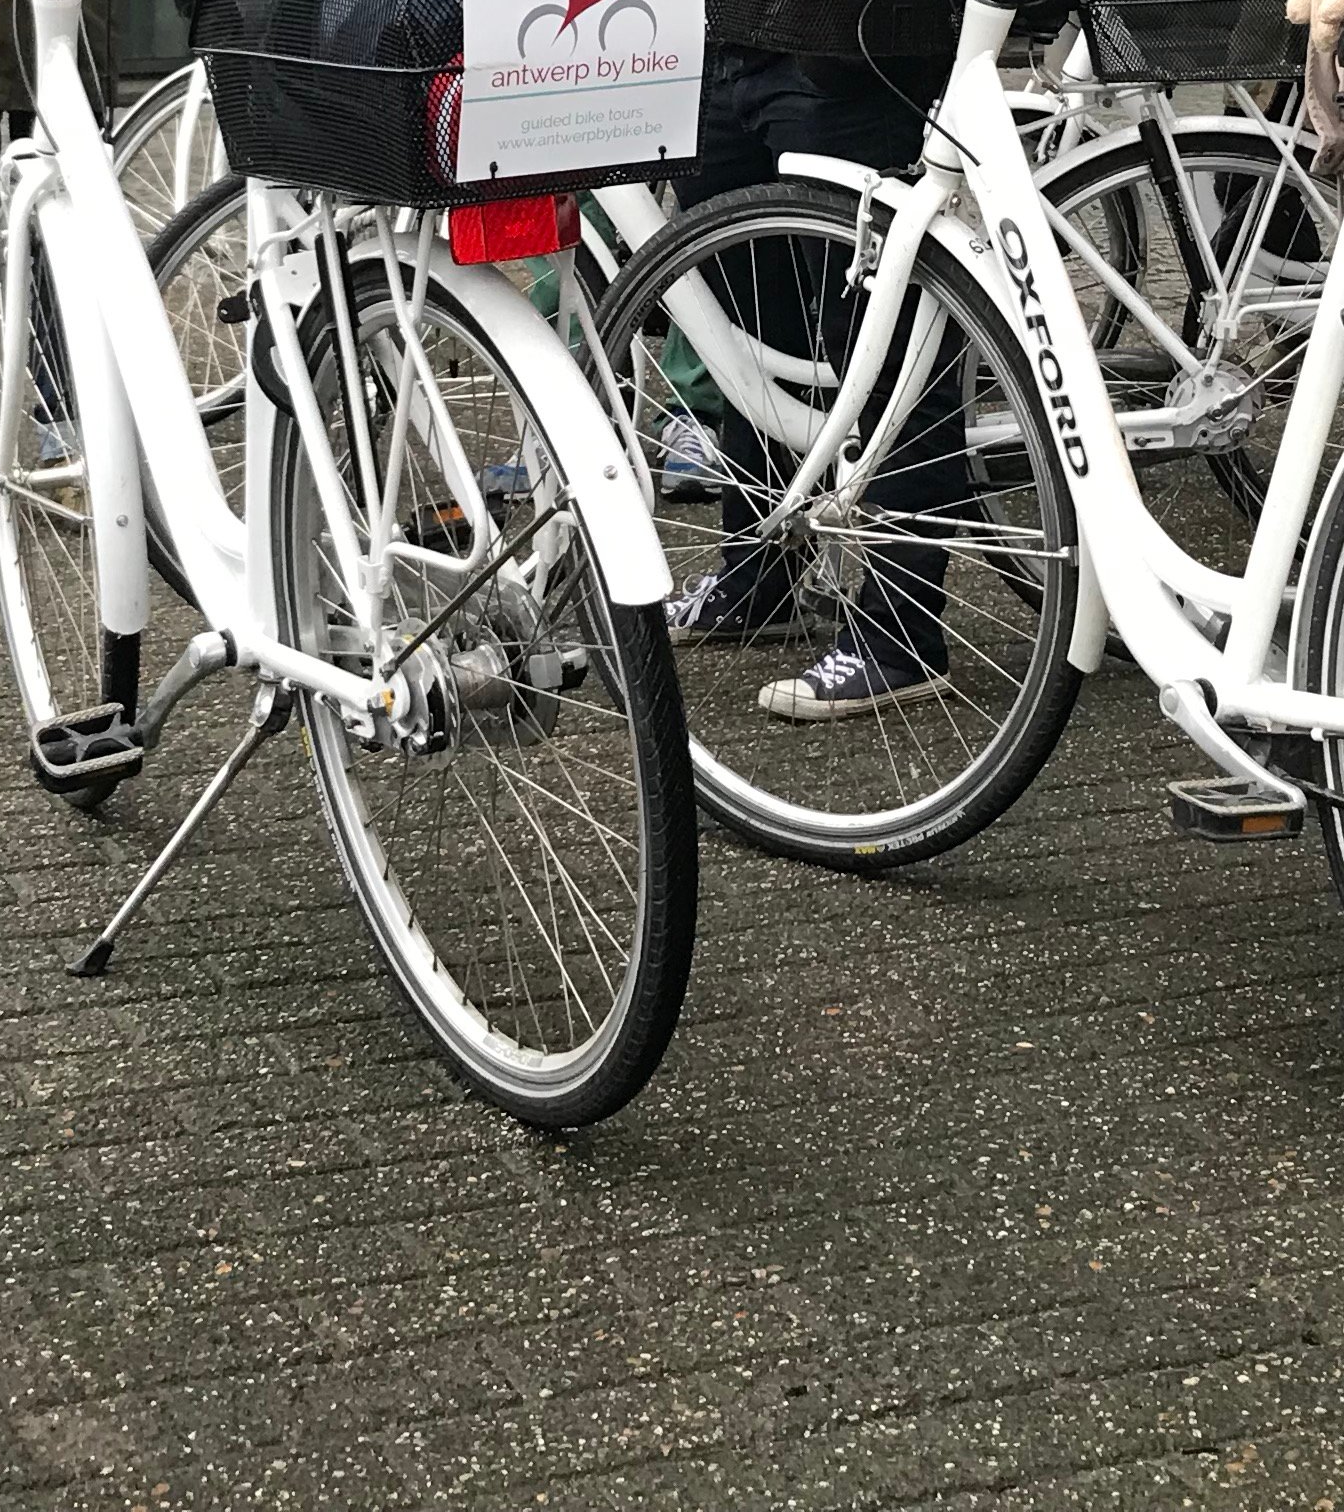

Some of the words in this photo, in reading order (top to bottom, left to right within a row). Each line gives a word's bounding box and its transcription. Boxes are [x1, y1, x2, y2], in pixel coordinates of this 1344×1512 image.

[491, 62, 590, 88] antwerp
[597, 56, 626, 82] by
[631, 51, 680, 75] bike
[496, 121, 663, 151] www.antwerpbybike.be
[520, 113, 571, 134] guided
[575, 110, 605, 126] bike
[608, 107, 644, 122] tours
[996, 217, 1089, 478] OXFORD
